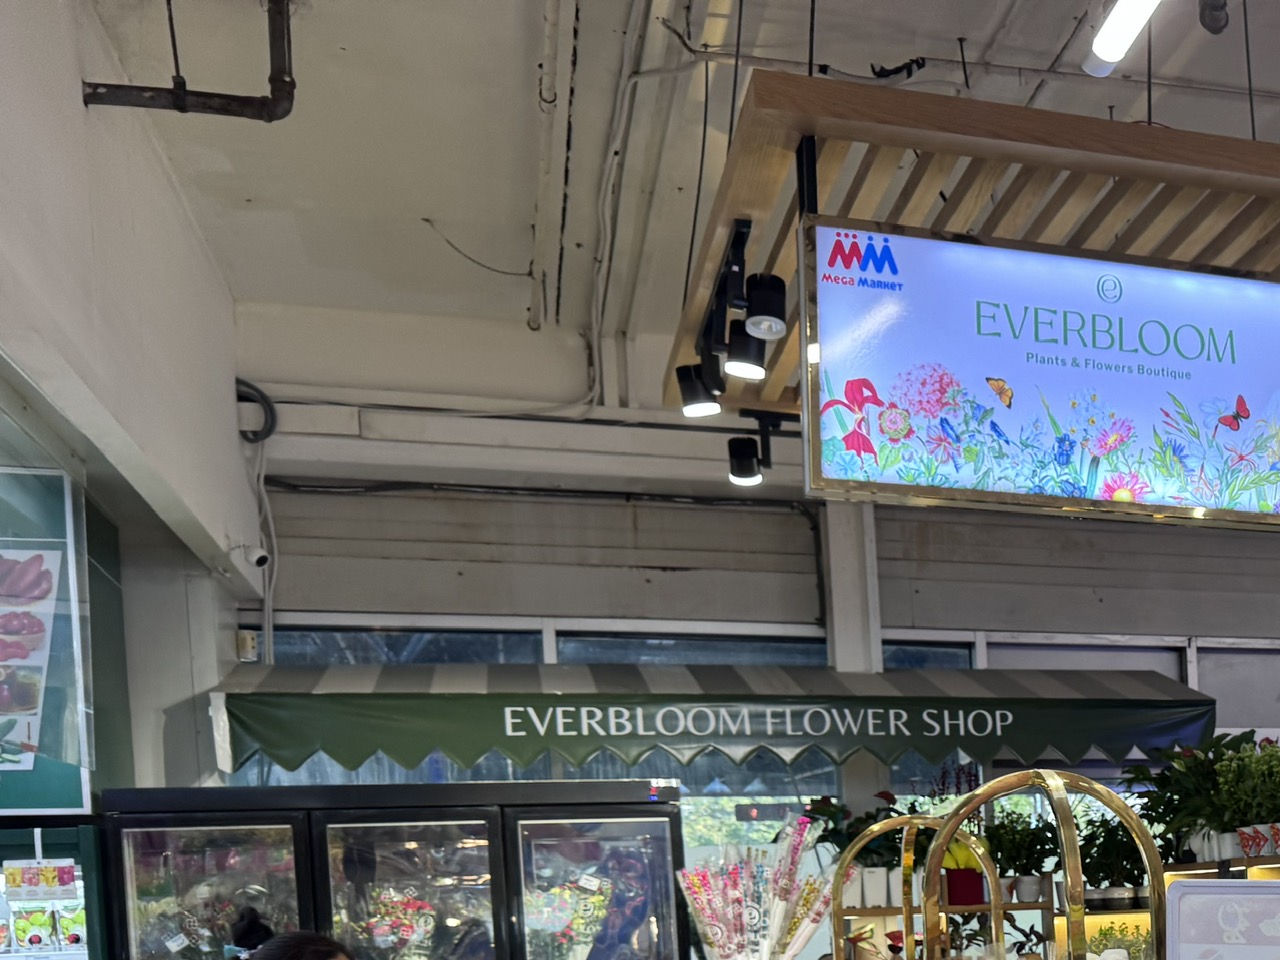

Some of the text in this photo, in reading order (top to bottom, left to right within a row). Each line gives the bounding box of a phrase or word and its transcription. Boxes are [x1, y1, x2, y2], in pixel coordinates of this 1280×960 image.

[975, 300, 1237, 365] EVERBLOOM
[1025, 352, 1192, 382] Plants & Flowers Boutique
[504, 707, 1015, 738] EVERBLOOM FLOWER SHOP
